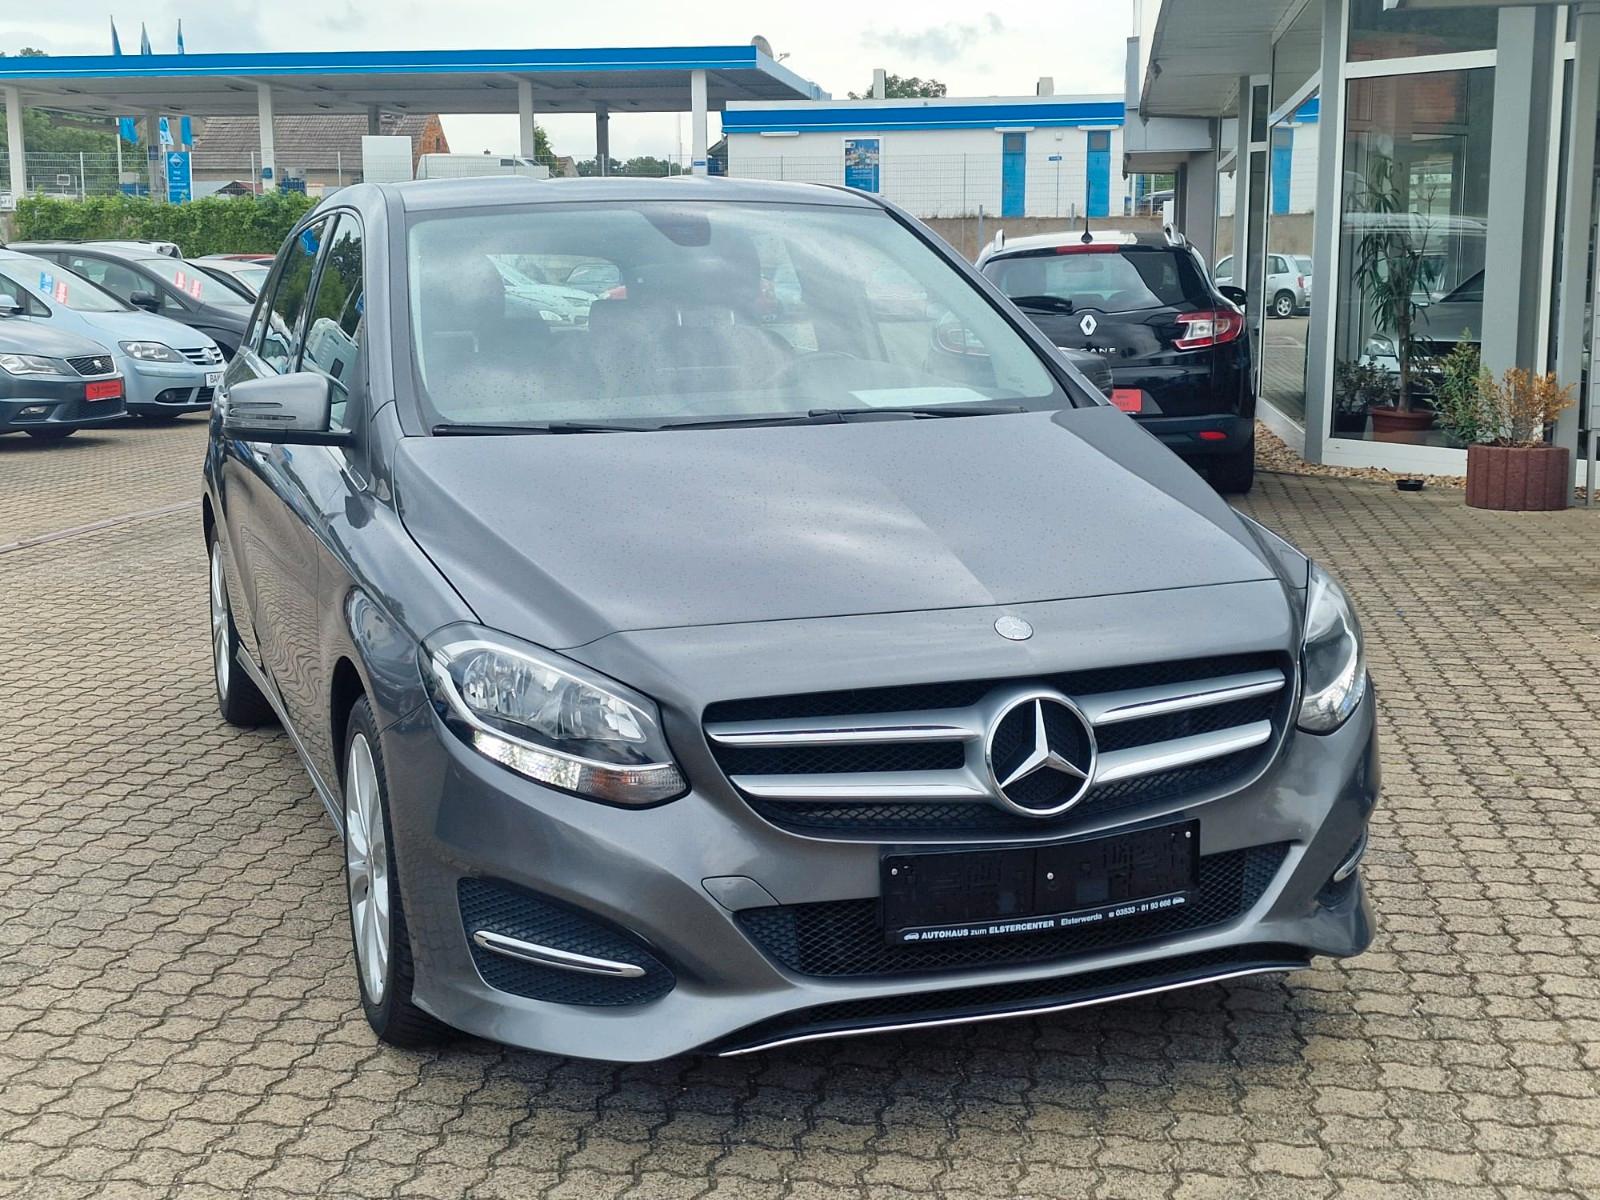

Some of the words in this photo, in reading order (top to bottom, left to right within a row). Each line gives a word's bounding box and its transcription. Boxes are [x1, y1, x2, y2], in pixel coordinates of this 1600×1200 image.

[921, 928, 969, 940] AUTOHAUS
[970, 928, 987, 936] zum
[988, 919, 1055, 934] ELSTERCENTER
[1060, 912, 1103, 926] Elsterwerda
